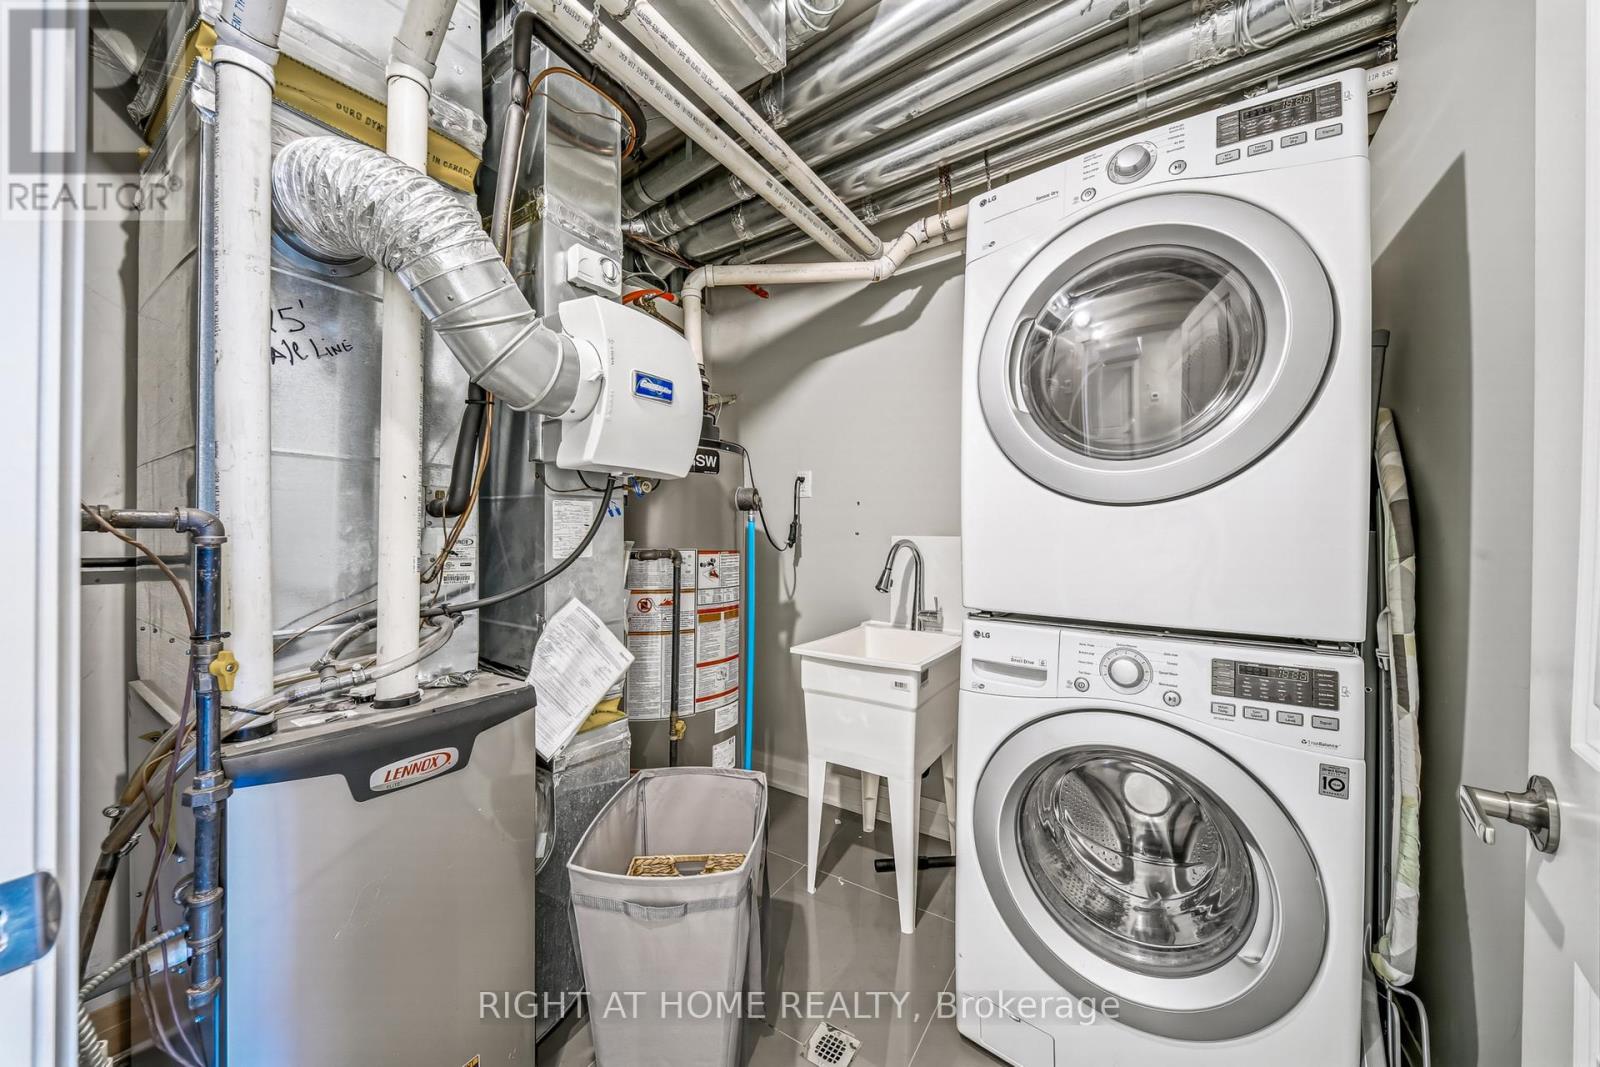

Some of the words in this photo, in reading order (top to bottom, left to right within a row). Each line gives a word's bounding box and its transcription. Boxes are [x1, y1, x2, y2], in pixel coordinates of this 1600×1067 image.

[336, 102, 363, 122] DURO
[694, 454, 717, 468] SW
[384, 755, 439, 783] LENNOX
[1322, 776, 1346, 792] 10
